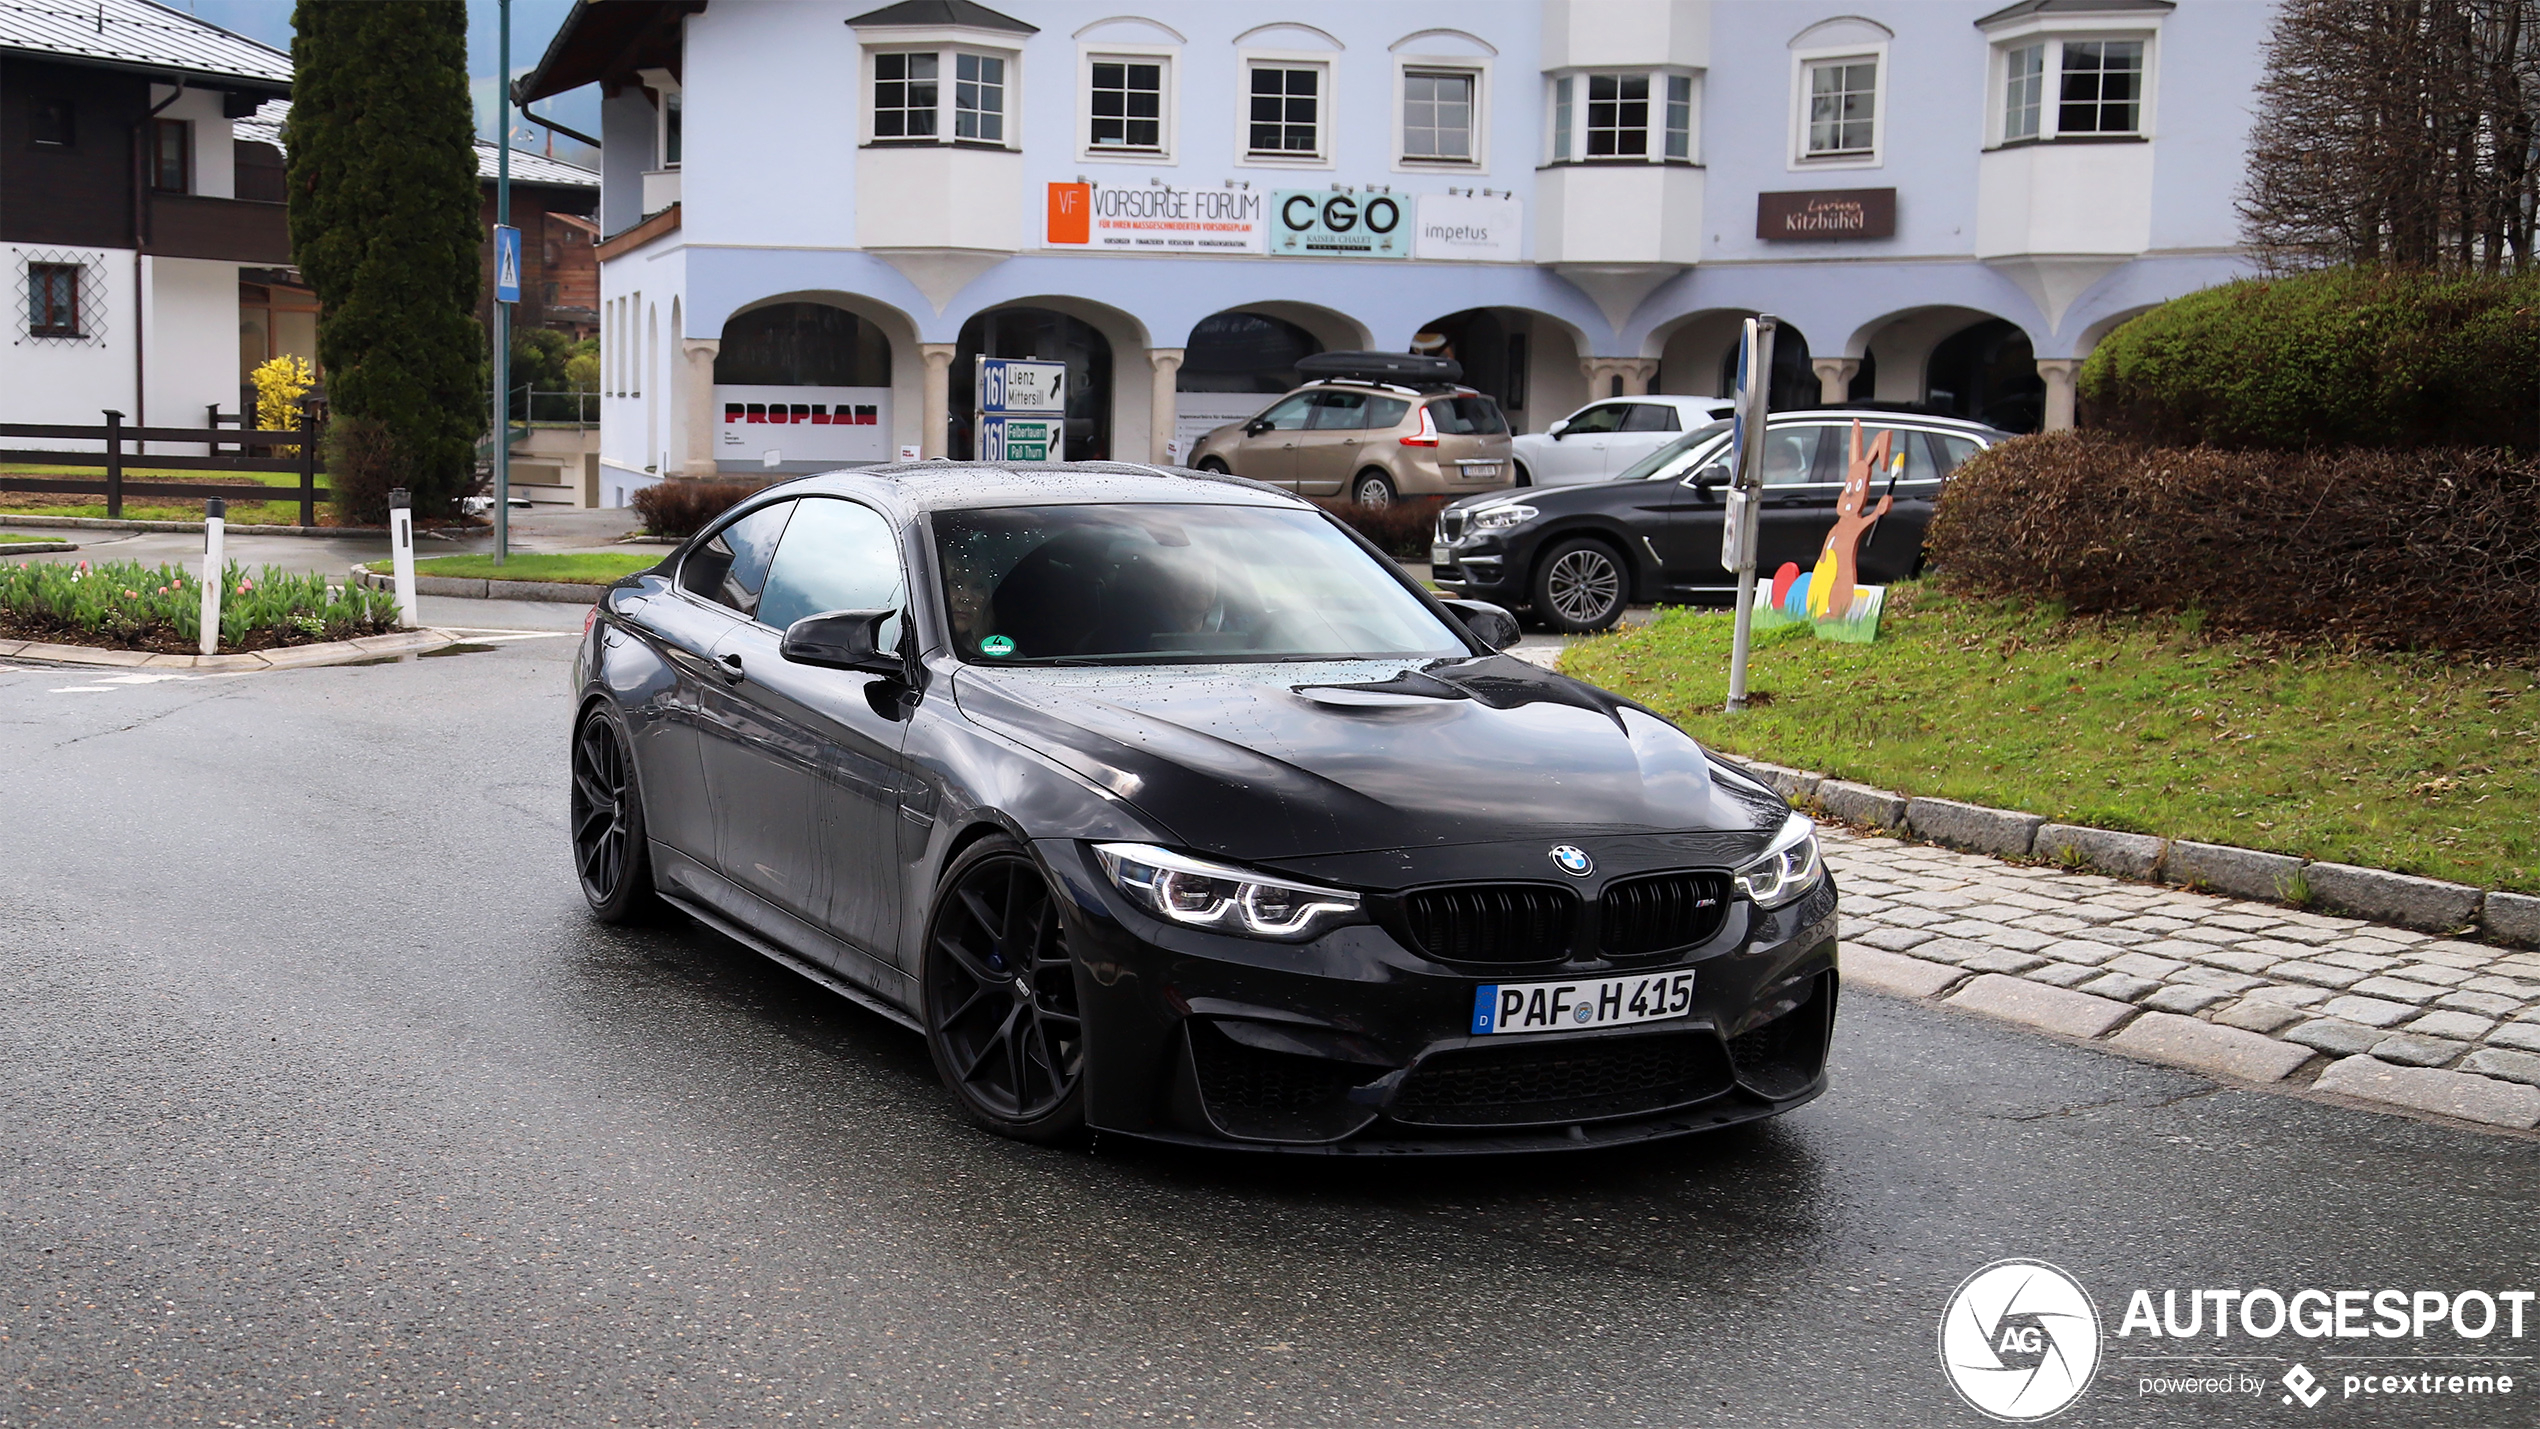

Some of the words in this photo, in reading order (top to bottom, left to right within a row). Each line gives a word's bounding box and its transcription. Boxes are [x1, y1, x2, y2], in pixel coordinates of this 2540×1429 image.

[1058, 190, 1079, 214] VF
[1093, 190, 1189, 219] VORSORGE
[1195, 192, 1260, 220] FORUM
[1282, 194, 1400, 234] CGO
[1786, 211, 1864, 231] Kitzbühel
[1112, 220, 1132, 229] IHREN
[1425, 222, 1488, 242] impetus
[1306, 234, 1337, 243] KAISER
[1338, 235, 1372, 244] CHALET
[984, 366, 1005, 406] 161
[1008, 366, 1035, 386] Lienz
[1008, 389, 1044, 405] Mittersill
[725, 402, 878, 426] PROPLAN
[1008, 424, 1047, 438] Felbertauern
[984, 422, 1003, 461] 161
[1025, 445, 1042, 458] Thurn
[993, 636, 1003, 645] 4
[1500, 986, 1577, 1028] PAF
[1597, 982, 1623, 1021] H
[1628, 974, 1693, 1017] 415
[1479, 1015, 1489, 1026] D
